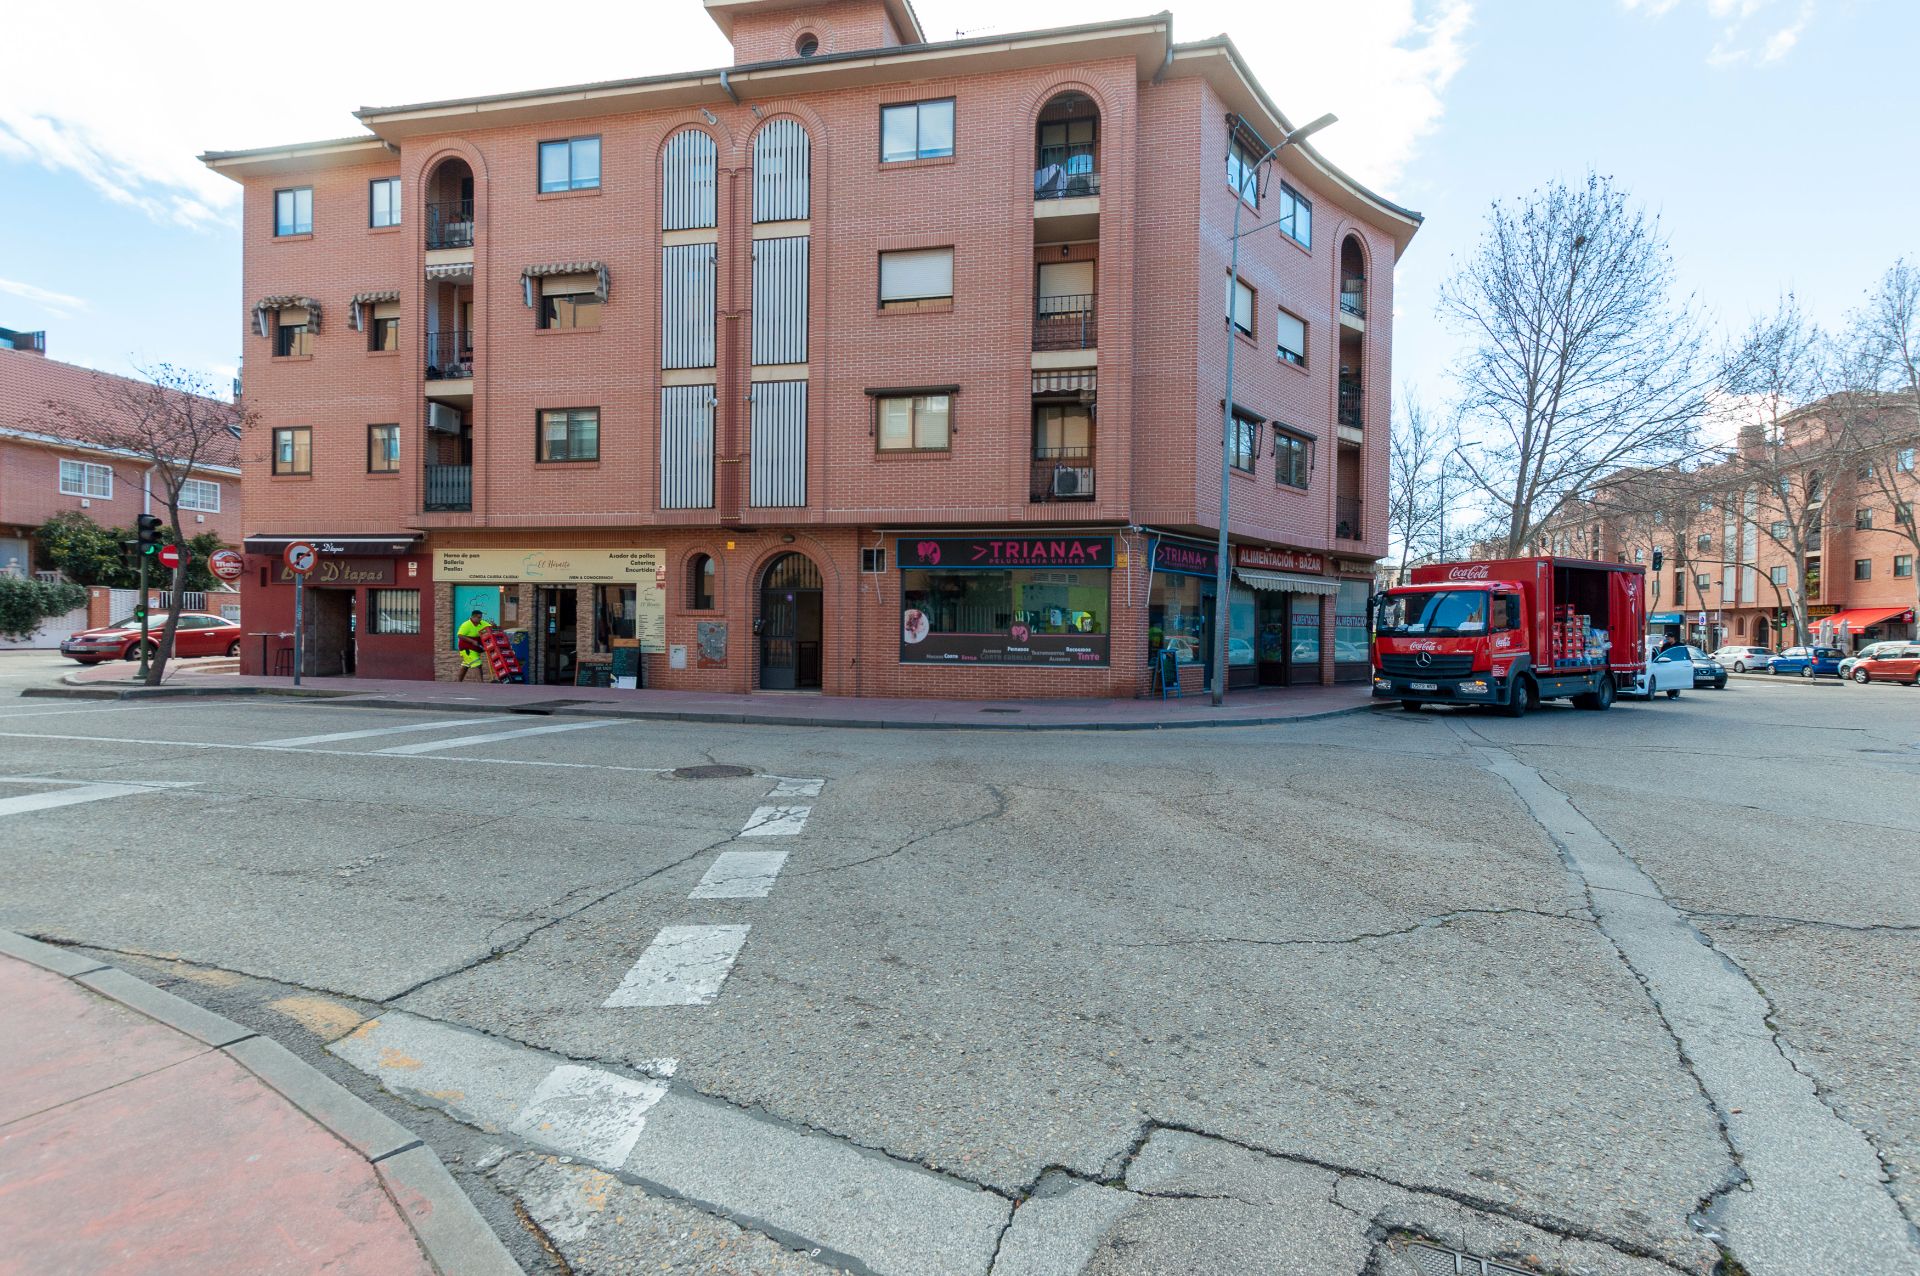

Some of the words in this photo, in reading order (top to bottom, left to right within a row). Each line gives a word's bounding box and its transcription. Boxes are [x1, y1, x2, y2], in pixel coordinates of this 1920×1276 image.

[989, 541, 1086, 558] TRIANA
[1164, 547, 1202, 565] TRIANA
[1240, 549, 1294, 568] ALIMENTACION
[1299, 557, 1321, 570] BAZAR
[320, 561, 383, 584] D'tapas
[1448, 565, 1491, 580] Coca-Cola
